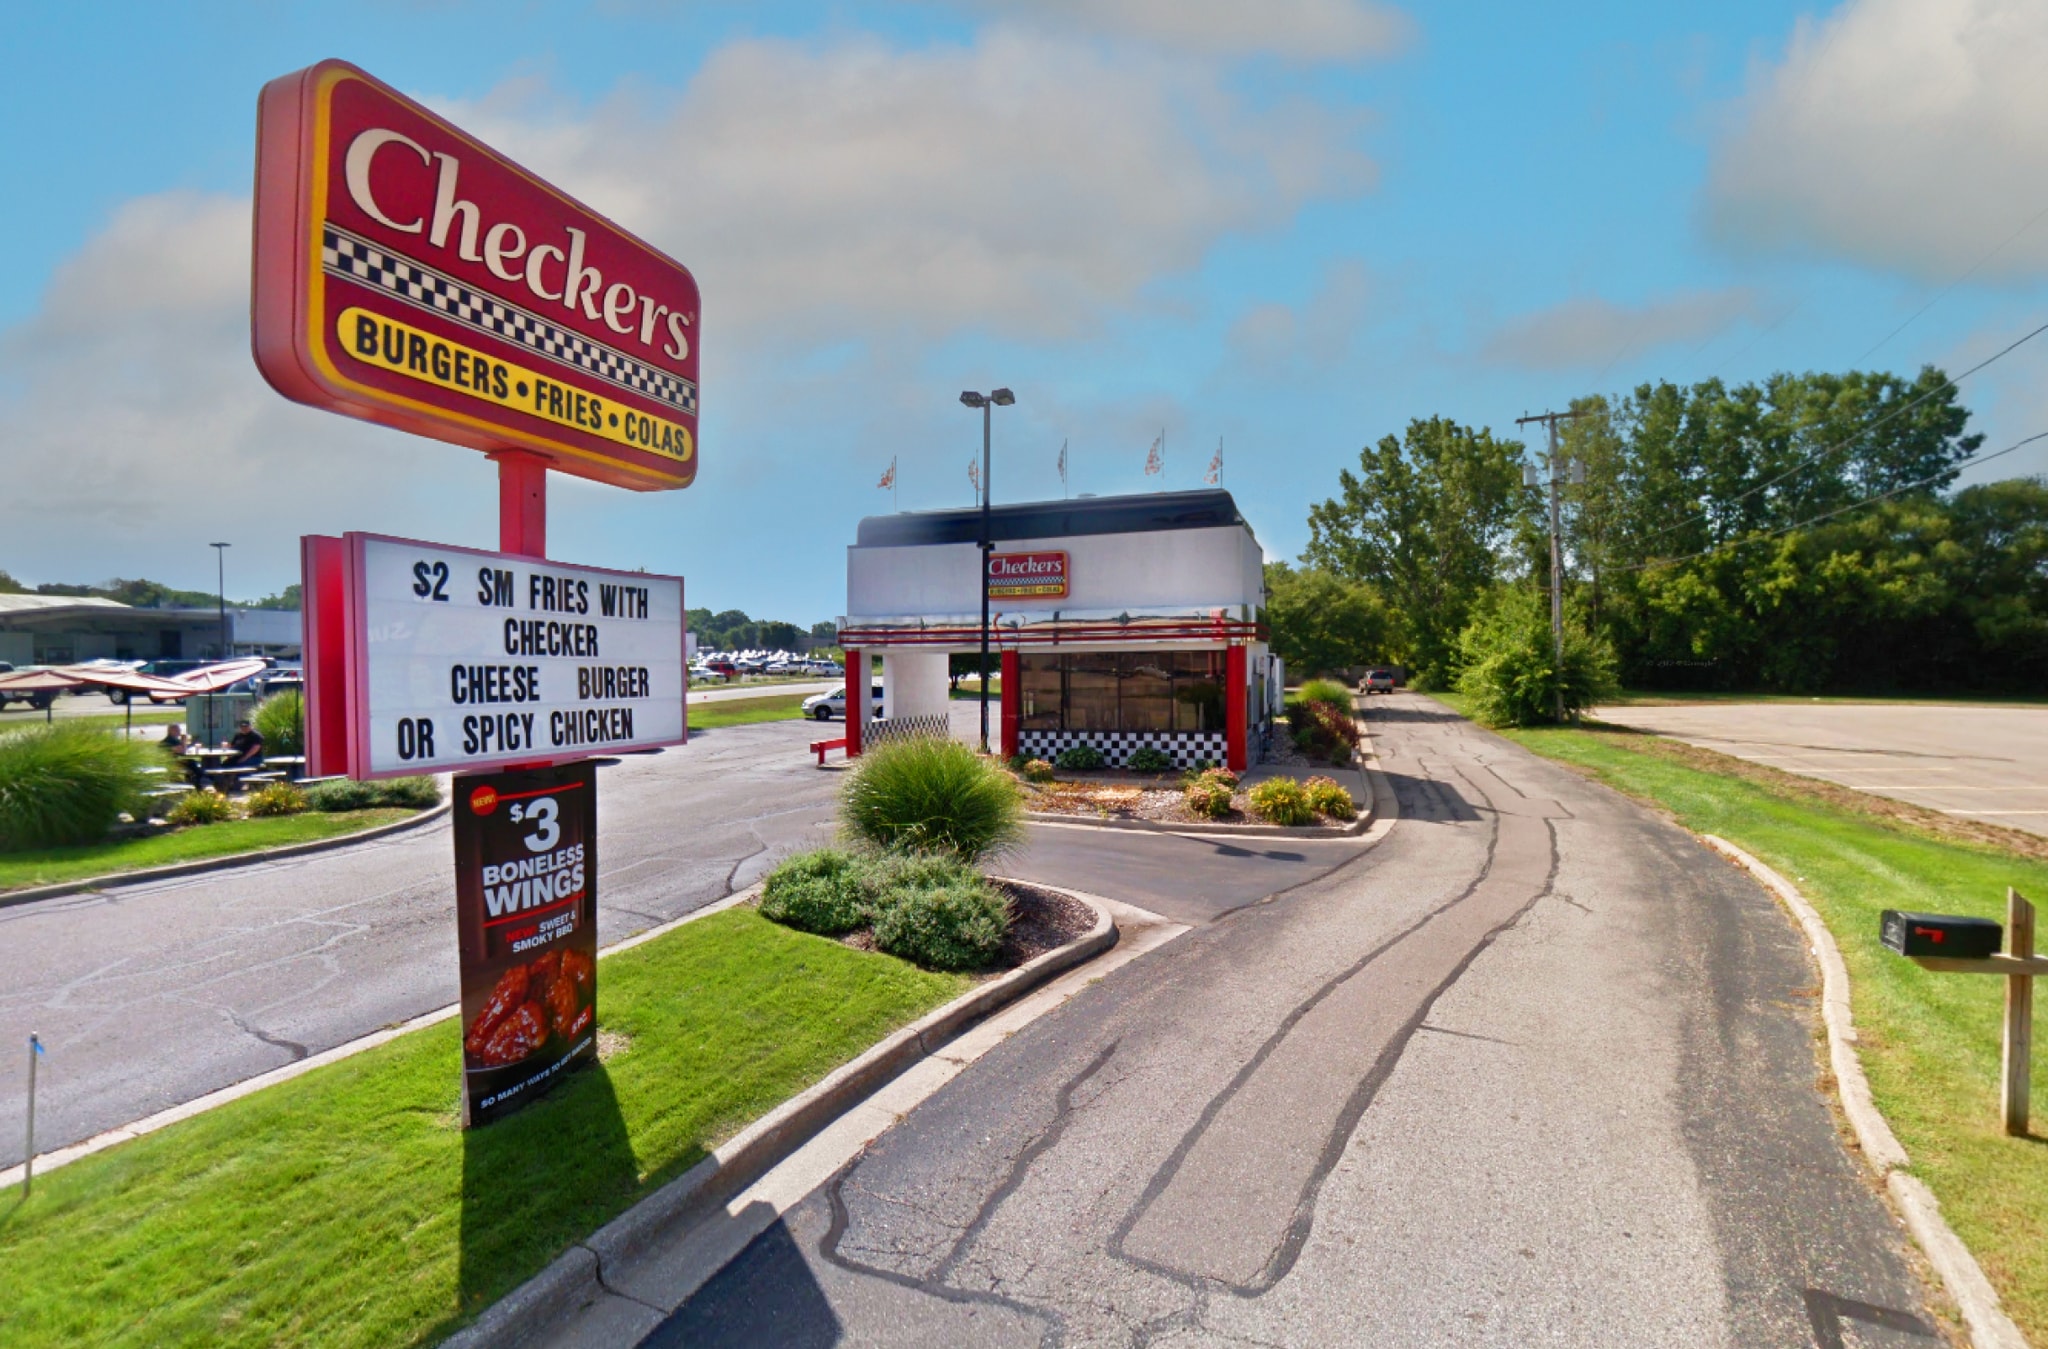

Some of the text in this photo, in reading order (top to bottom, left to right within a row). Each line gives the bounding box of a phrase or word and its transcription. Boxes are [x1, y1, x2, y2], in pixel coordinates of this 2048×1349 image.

[345, 128, 690, 360] Checkers
[356, 314, 685, 457] BURGERS FRIES COLAS
[988, 556, 1062, 575] Checkers
[413, 561, 648, 619] $2 SM FRIES WITH
[504, 618, 598, 657] CHECKER
[452, 665, 649, 704] CHEESE BURGER
[398, 708, 633, 760] OR SPICY CHICKEN
[483, 843, 584, 886] BONELESS
[484, 863, 585, 917] WINGS
[513, 930, 553, 953] SMOKY
[539, 912, 569, 932] SWEET
[497, 1082, 525, 1101] MANY
